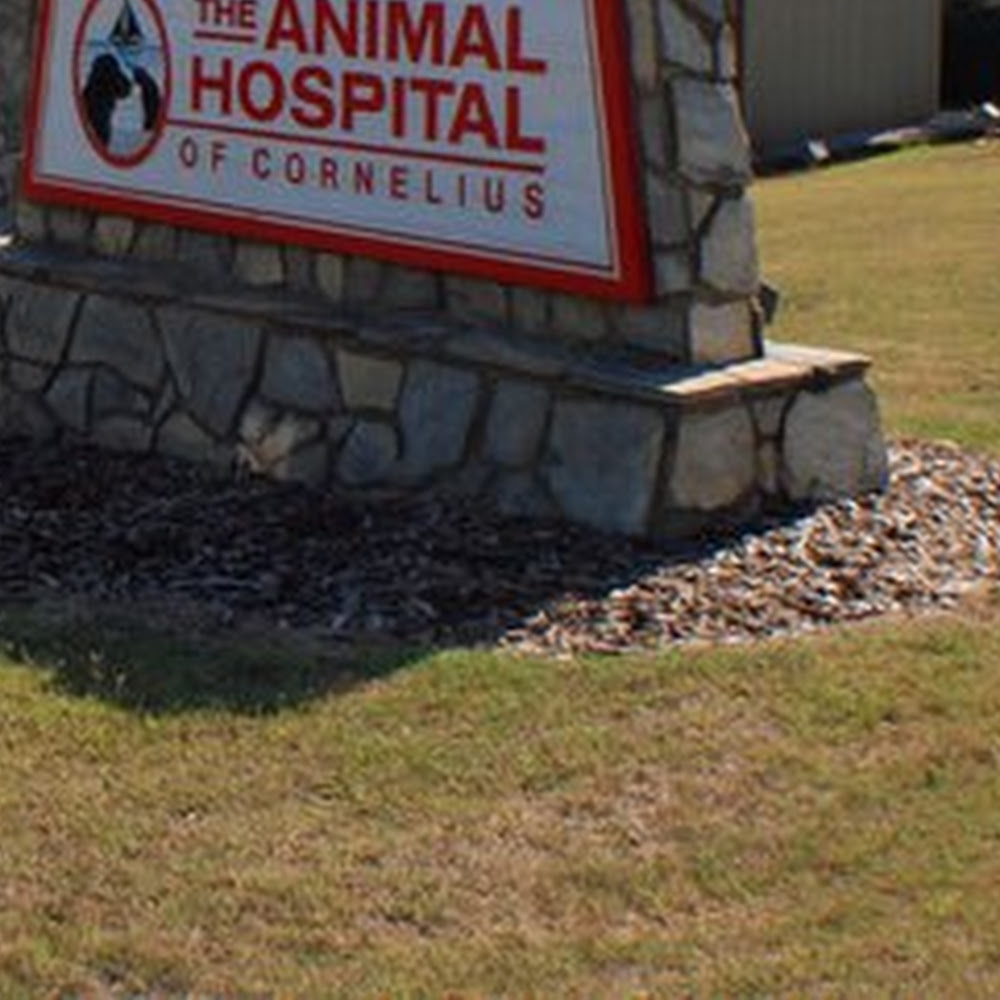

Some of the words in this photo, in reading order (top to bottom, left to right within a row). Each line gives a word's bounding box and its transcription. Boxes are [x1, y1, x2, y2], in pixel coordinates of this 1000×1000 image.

[190, 55, 547, 154] HOSPITAL
[179, 136, 229, 172] OF
[251, 148, 546, 220] CORNELIUS
